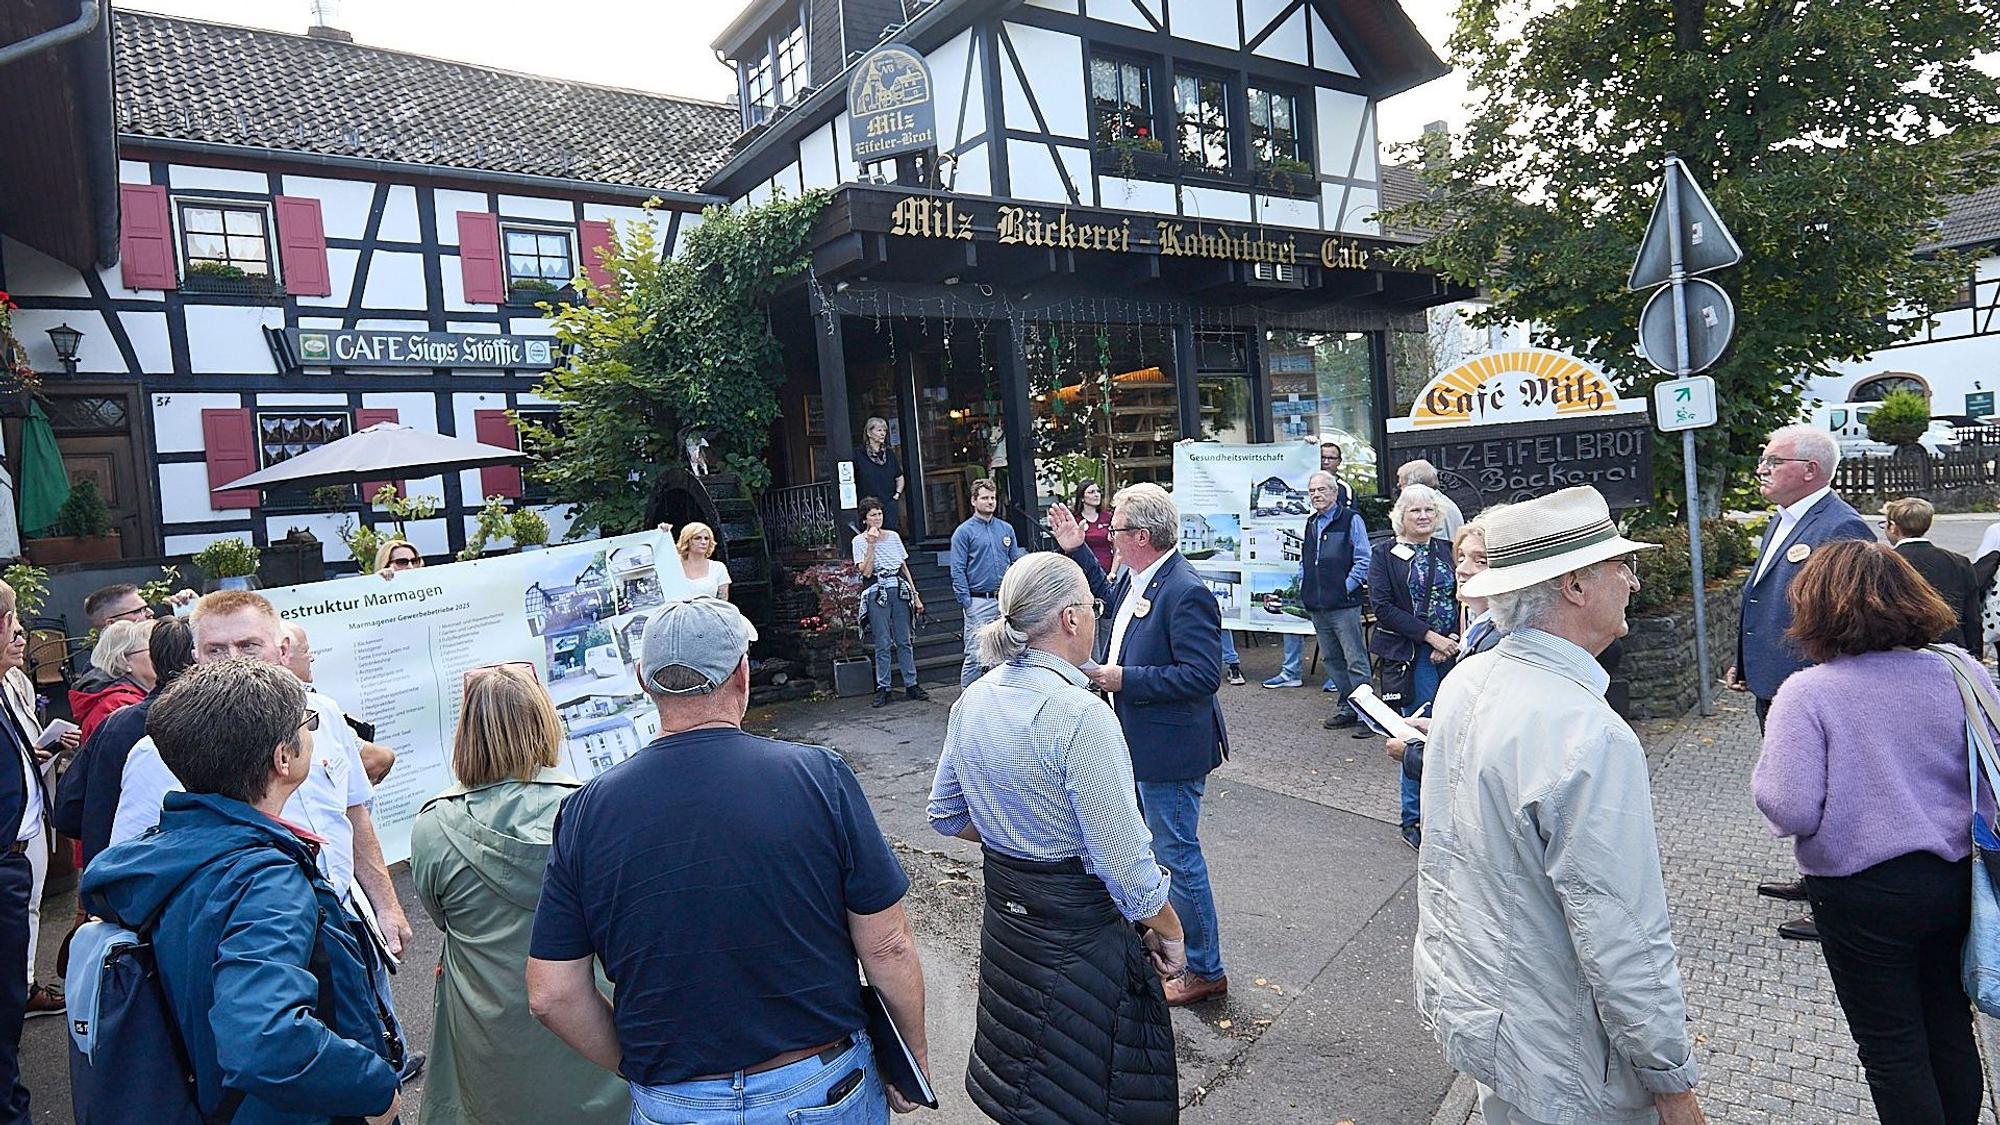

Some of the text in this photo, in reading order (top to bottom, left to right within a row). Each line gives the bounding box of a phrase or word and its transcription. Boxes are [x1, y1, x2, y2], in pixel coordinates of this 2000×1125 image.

[866, 112, 915, 137] Milz
[855, 129, 932, 155] Eifeler-Brot
[891, 197, 975, 241] Milz
[996, 206, 1130, 252] Bäckerei
[1157, 221, 1297, 265] Konditorei
[335, 335, 405, 360] CAFE
[156, 396, 171, 407] 37
[1426, 374, 1605, 420] Café Milz
[1190, 453, 1284, 462] Gesundheitswirtschaft
[280, 585, 443, 620] estruktur Marmagen
[348, 617, 397, 630] Marmagener
[397, 606, 454, 622] Gewerbebetriebe
[455, 602, 470, 611] 2025
